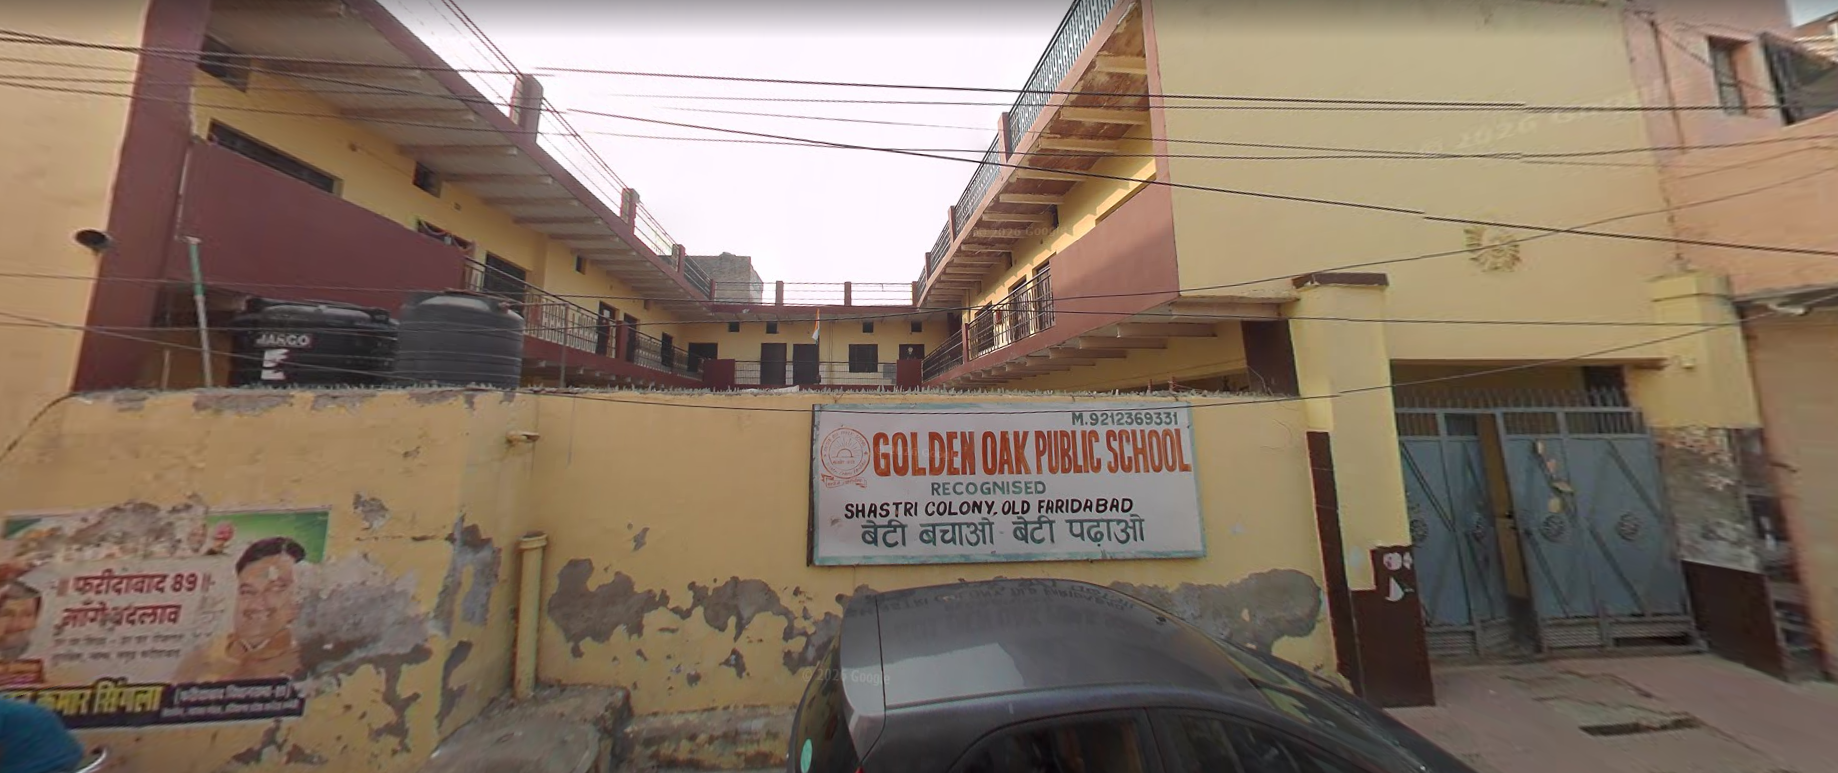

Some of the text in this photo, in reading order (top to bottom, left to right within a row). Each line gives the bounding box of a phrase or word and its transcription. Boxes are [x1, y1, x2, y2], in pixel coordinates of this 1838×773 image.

[1072, 411, 1178, 426] M.9212369331
[873, 430, 976, 477] GOLDEN
[981, 429, 1032, 475] OAK
[1034, 429, 1101, 475] PUBLIC
[1105, 427, 1192, 474] SCHOOL
[931, 480, 1046, 496] RECOGNISED
[844, 501, 918, 520] SHASTRI
[1001, 500, 1031, 515] OLD
[1037, 497, 1134, 515] FARIDABAD
[860, 513, 1145, 548] बेटी बचाओ बेटी पढ़ाओ
[73, 568, 198, 596] फरीदाबाद 89
